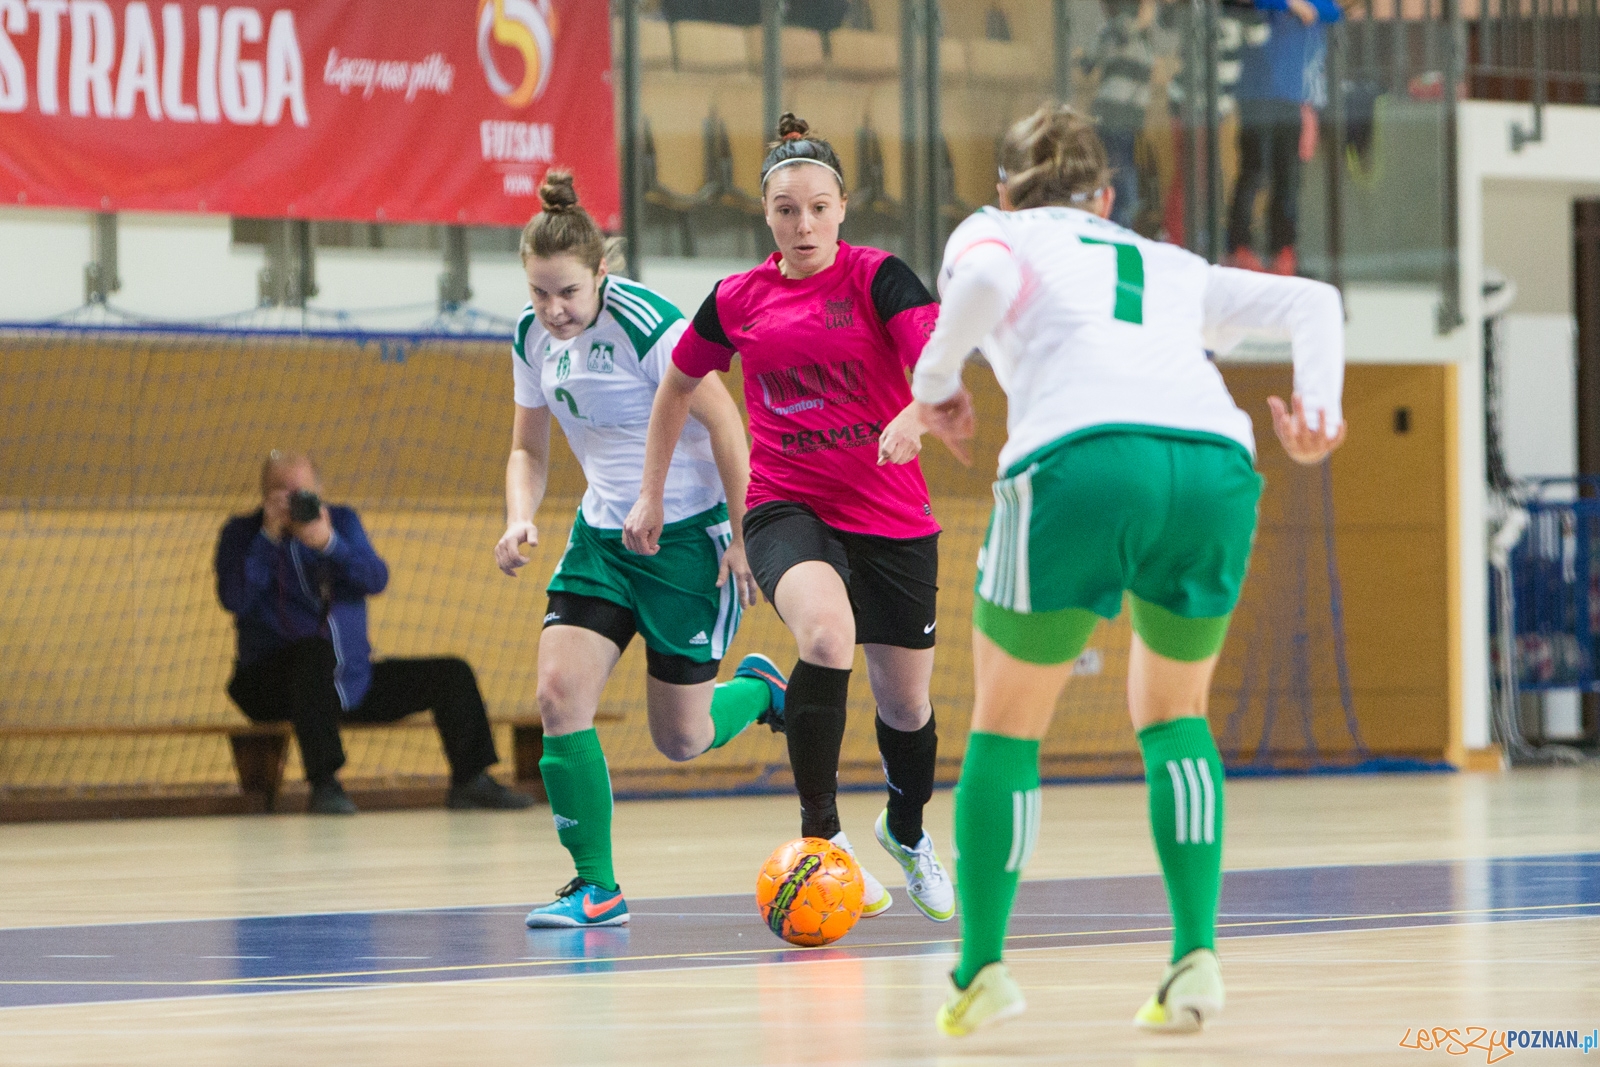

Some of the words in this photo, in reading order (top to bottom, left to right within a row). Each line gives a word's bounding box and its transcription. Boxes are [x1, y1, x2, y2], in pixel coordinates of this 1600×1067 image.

[480, 119, 555, 163] FUTSAL
[1078, 233, 1144, 325] 7
[554, 387, 588, 419] 2
[771, 398, 825, 415] inventory
[781, 420, 883, 450] PRIMEX
